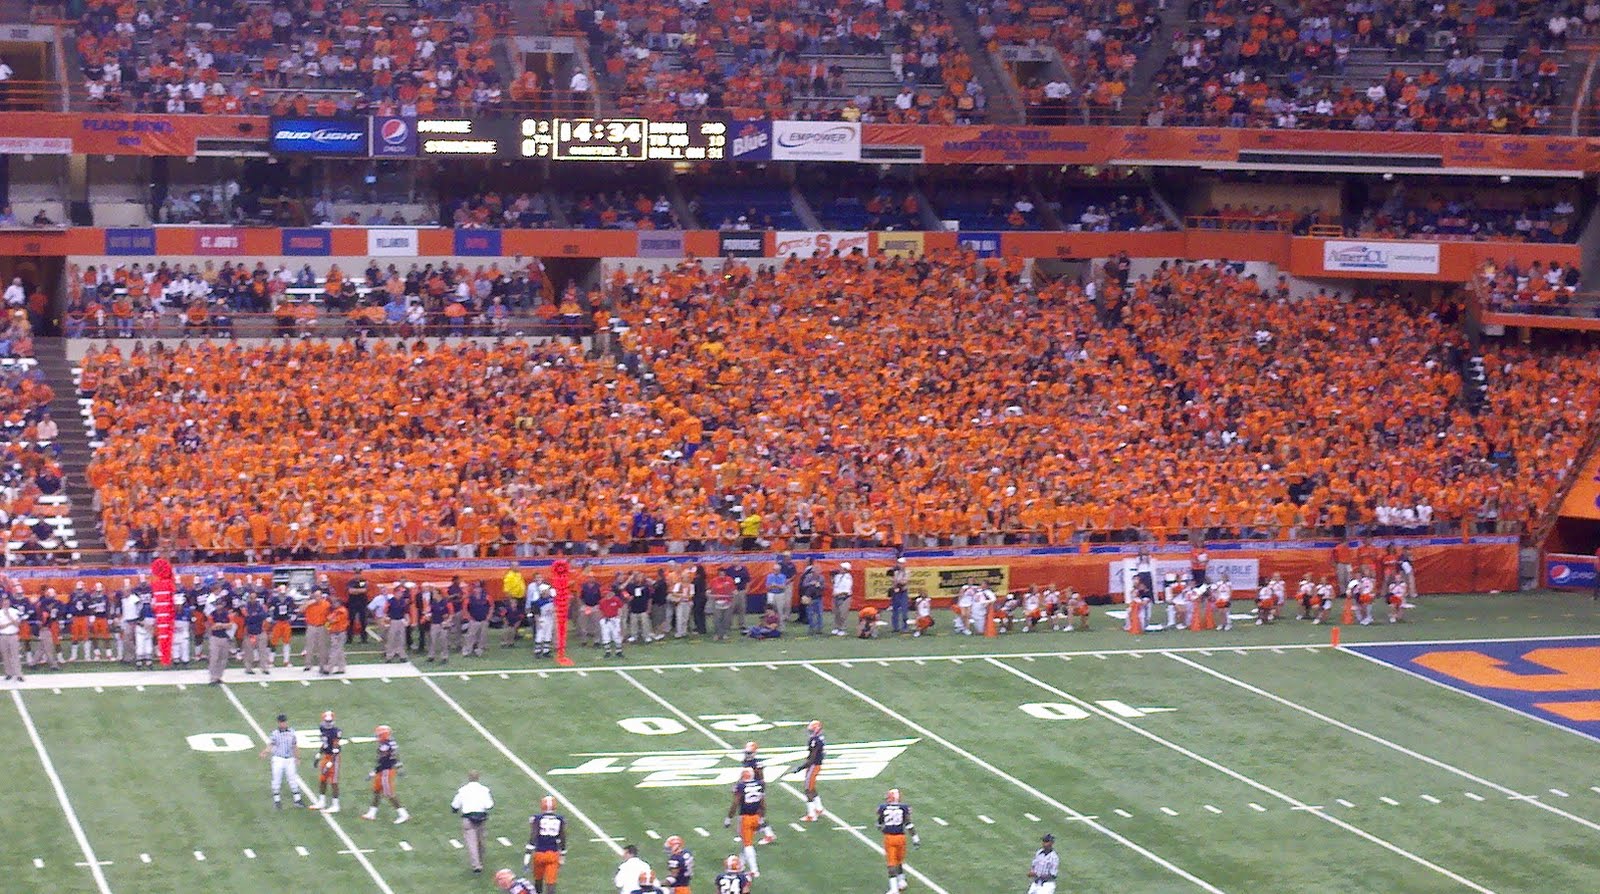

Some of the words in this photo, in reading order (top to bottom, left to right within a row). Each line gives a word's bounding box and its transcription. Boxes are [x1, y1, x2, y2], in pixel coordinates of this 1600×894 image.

[275, 130, 312, 139] BUD
[318, 132, 362, 140] LIGHT
[561, 123, 642, 142] 14:34
[790, 132, 847, 142] EMPOWER
